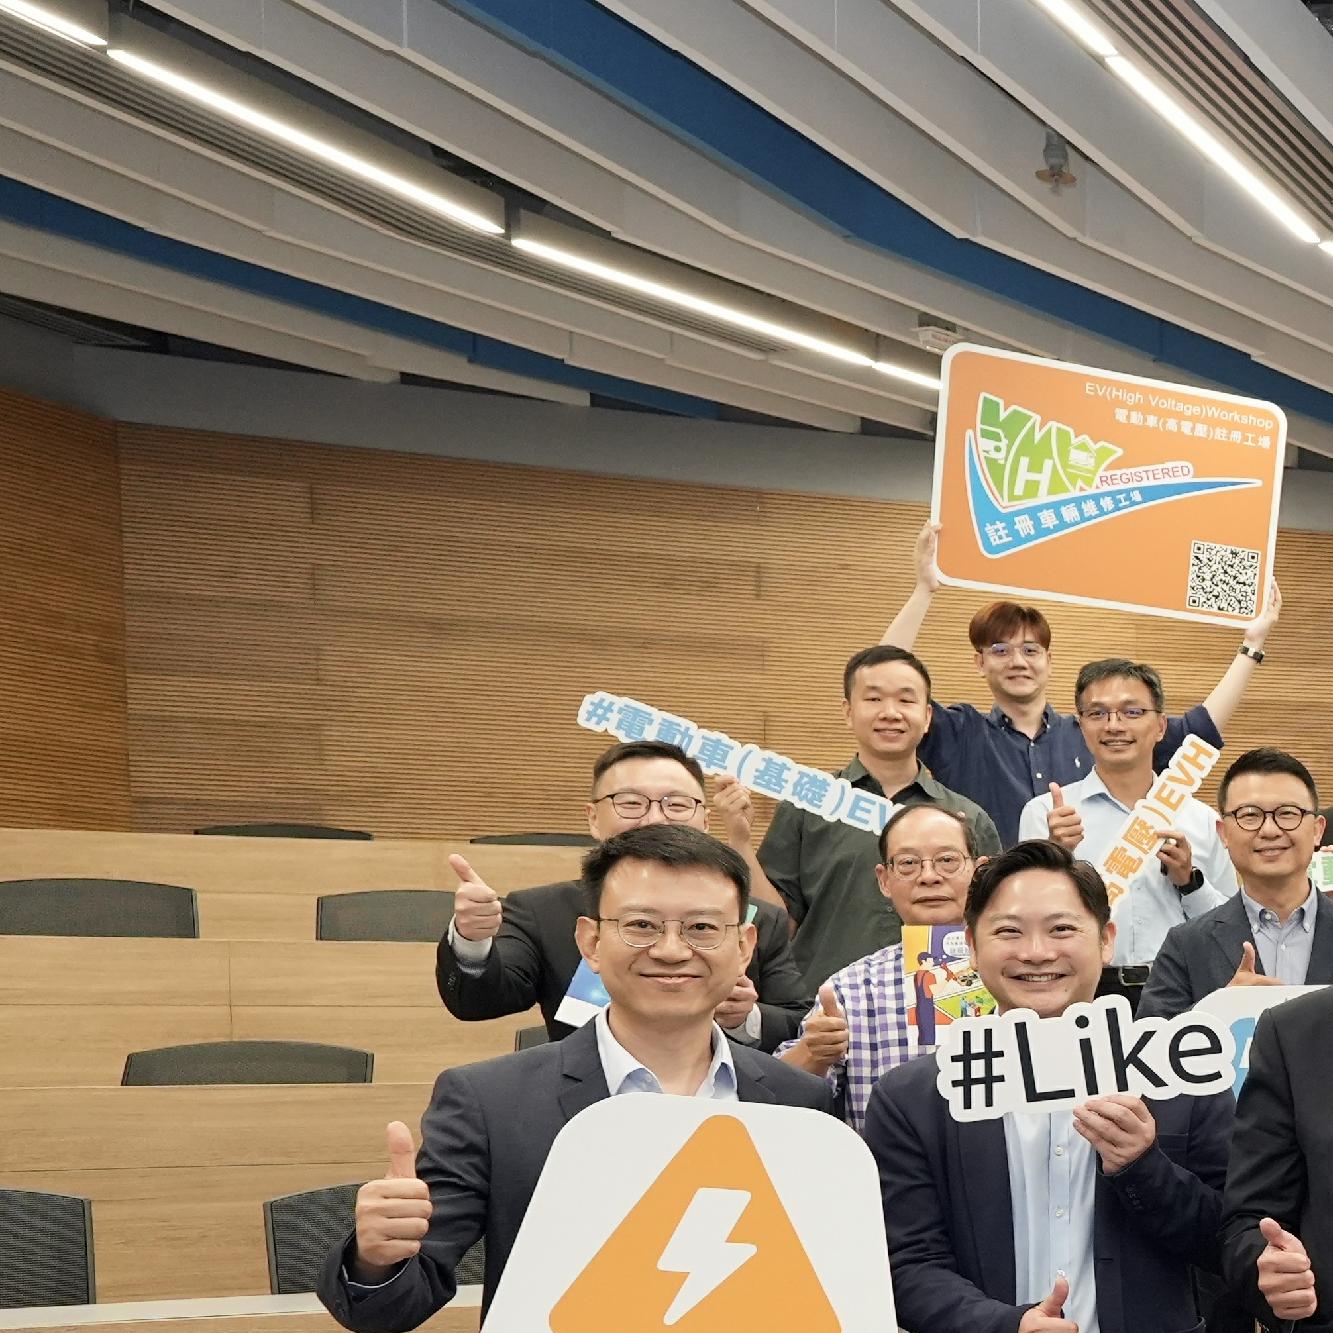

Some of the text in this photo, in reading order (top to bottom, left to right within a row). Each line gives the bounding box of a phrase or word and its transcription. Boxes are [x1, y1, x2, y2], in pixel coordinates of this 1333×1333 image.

[1085, 383, 1274, 430] EV(High Voltage)Workshop
[1099, 464, 1191, 487] REGISTERED
[983, 490, 1143, 547] 註冊車輛維修工場
[950, 1007, 1224, 1111] #Like
